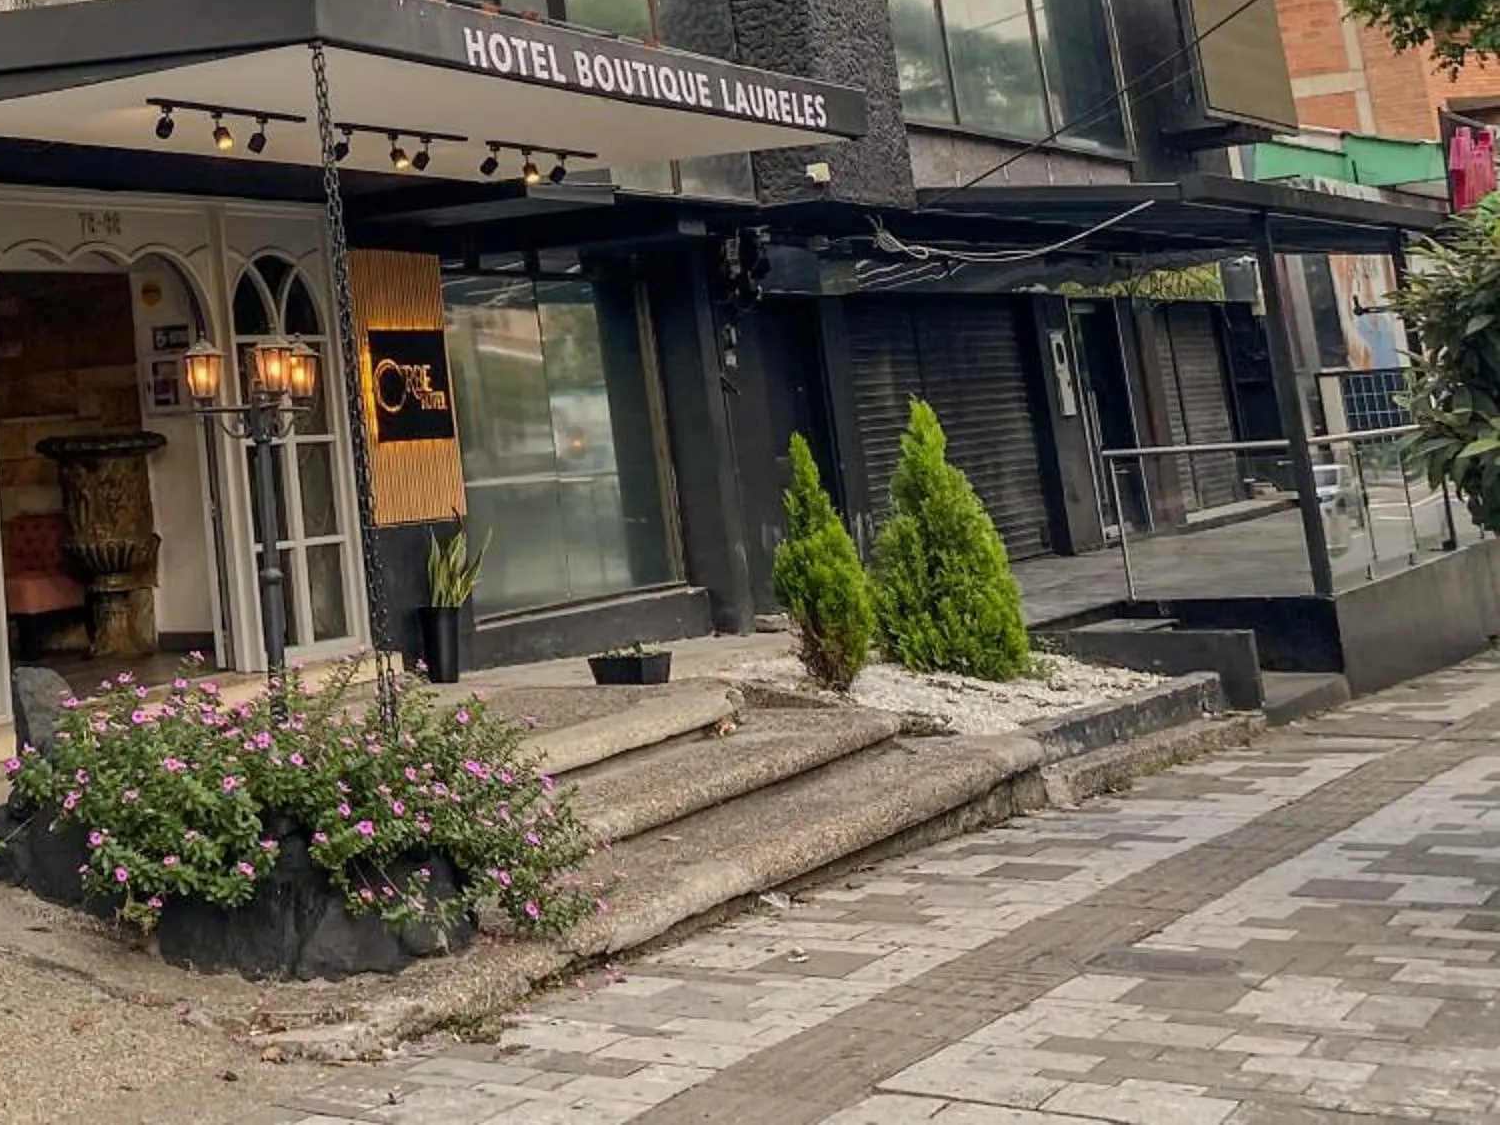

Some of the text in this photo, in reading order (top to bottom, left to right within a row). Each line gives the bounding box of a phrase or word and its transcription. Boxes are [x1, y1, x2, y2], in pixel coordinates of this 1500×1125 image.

[463, 27, 827, 128] HOTEL BOUTIQUE LAURELES
